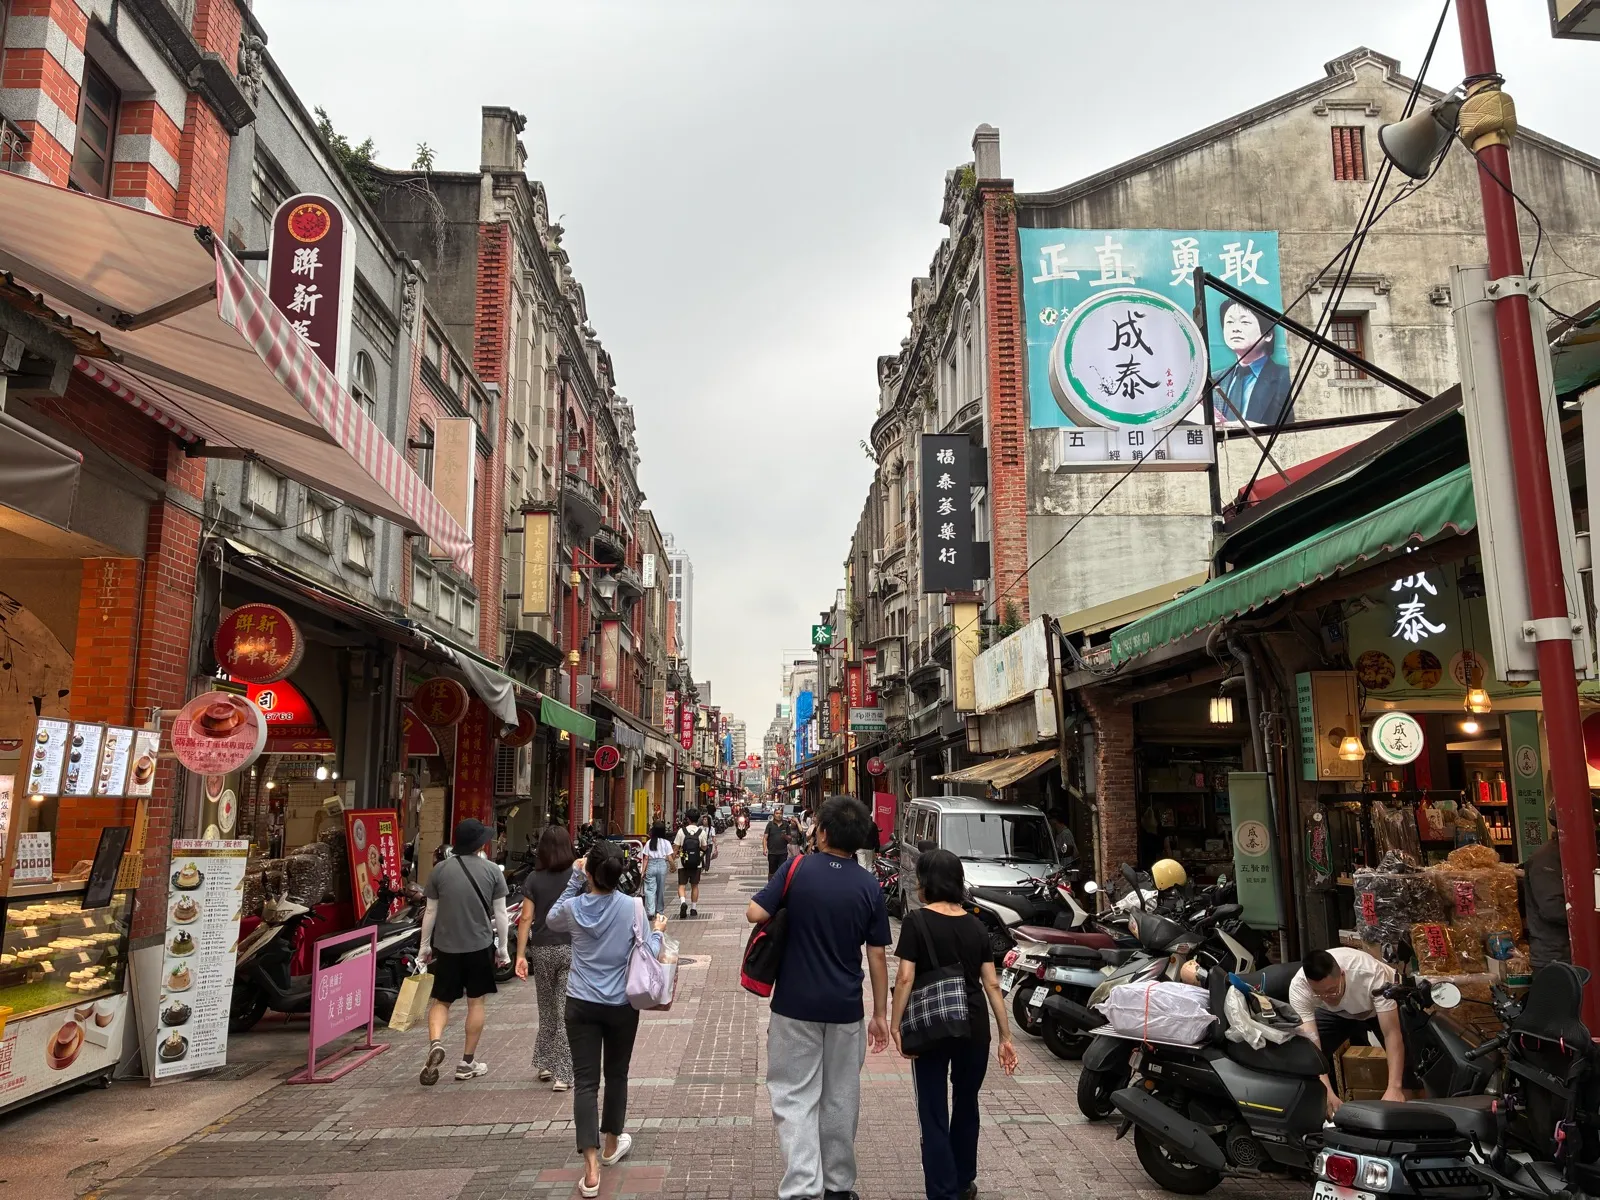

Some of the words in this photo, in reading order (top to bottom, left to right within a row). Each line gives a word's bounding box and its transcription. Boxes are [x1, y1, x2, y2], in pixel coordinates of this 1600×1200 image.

[1108, 310, 1161, 399] 成泰
[1069, 431, 1204, 447] 五印醋
[1109, 450, 1166, 460] 經銷商
[936, 449, 957, 565] 福泰蔘藥行
[235, 613, 278, 634] 聯新
[814, 626, 830, 642] 茶
[226, 648, 281, 666] 停車場
[1363, 894, 1376, 925] 黑木耳
[1428, 927, 1447, 956] 石花菜
